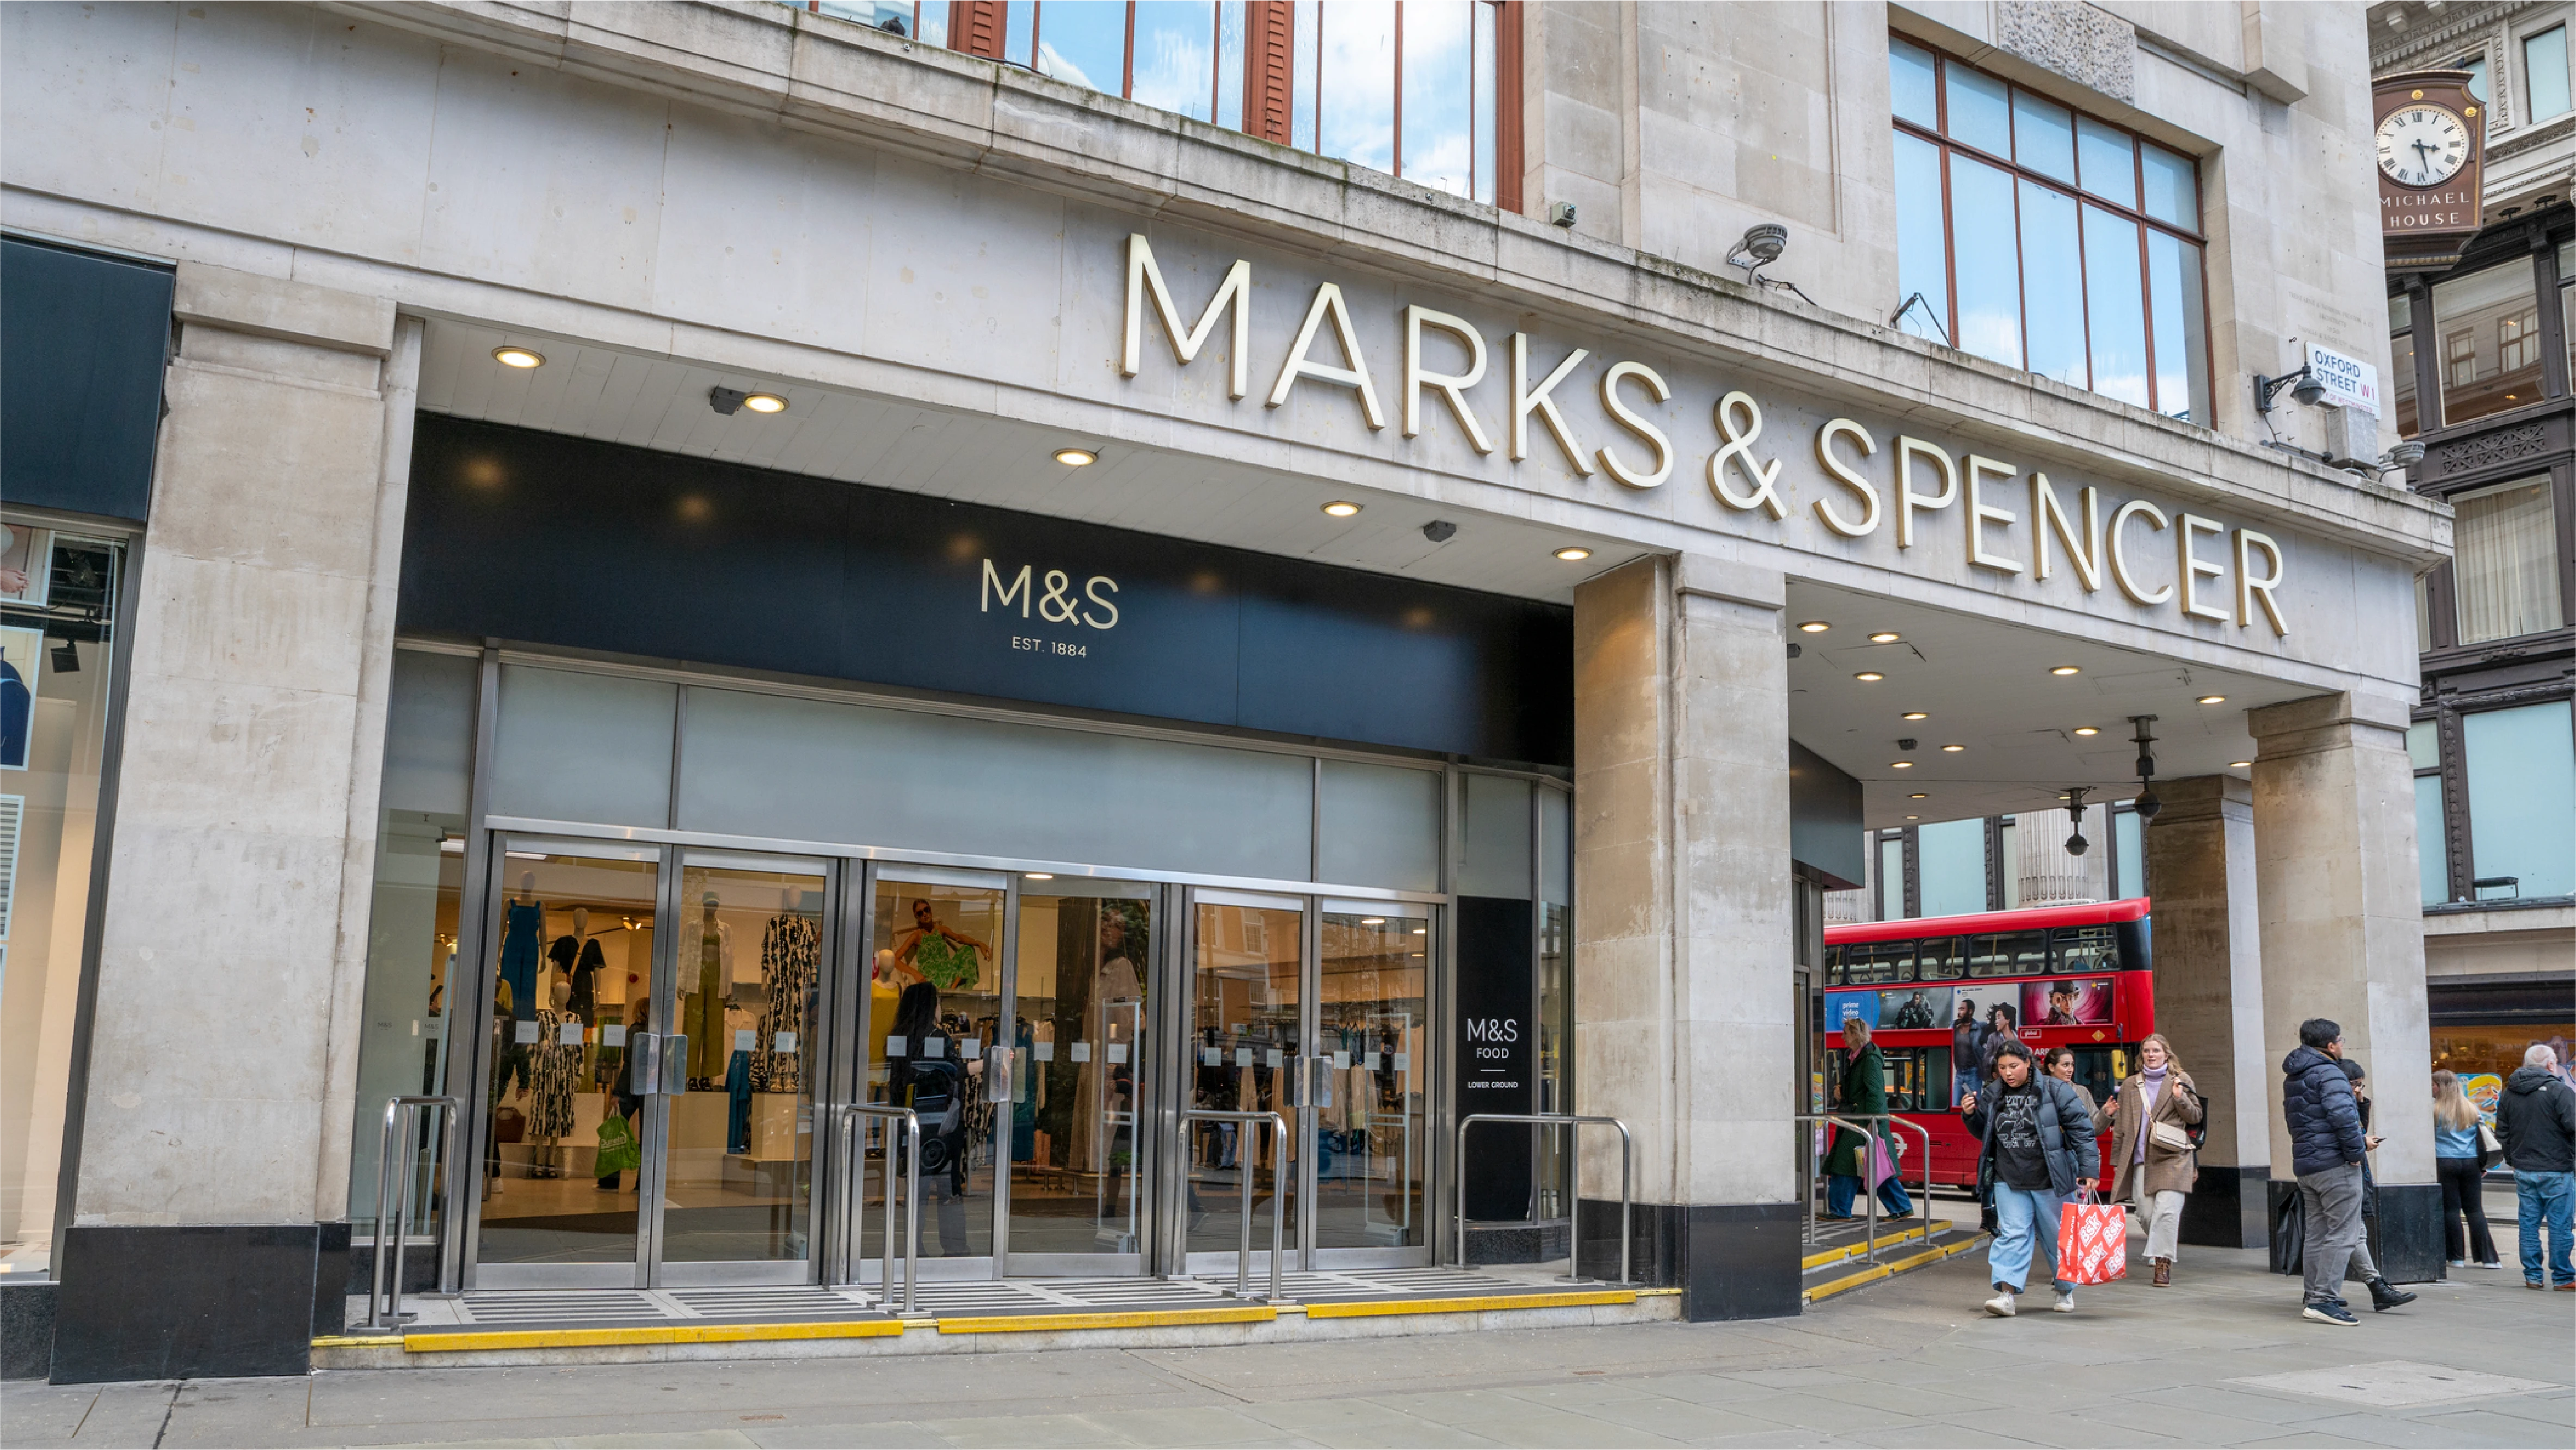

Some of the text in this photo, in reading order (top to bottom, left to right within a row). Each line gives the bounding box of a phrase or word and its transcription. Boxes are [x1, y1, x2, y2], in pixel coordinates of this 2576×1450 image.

[2379, 192, 2469, 207] MICHAEL
[2390, 212, 2460, 227] HOUSE
[2314, 350, 2361, 378] OXFORD
[2316, 368, 2375, 401] STREET W1
[1121, 232, 2289, 636] MARKS & SPENCER
[981, 558, 1119, 630] M&S
[1012, 636, 1087, 658] EST. 1884
[1467, 1017, 1518, 1042] M&S
[1477, 1048, 1509, 1059] FOOD
